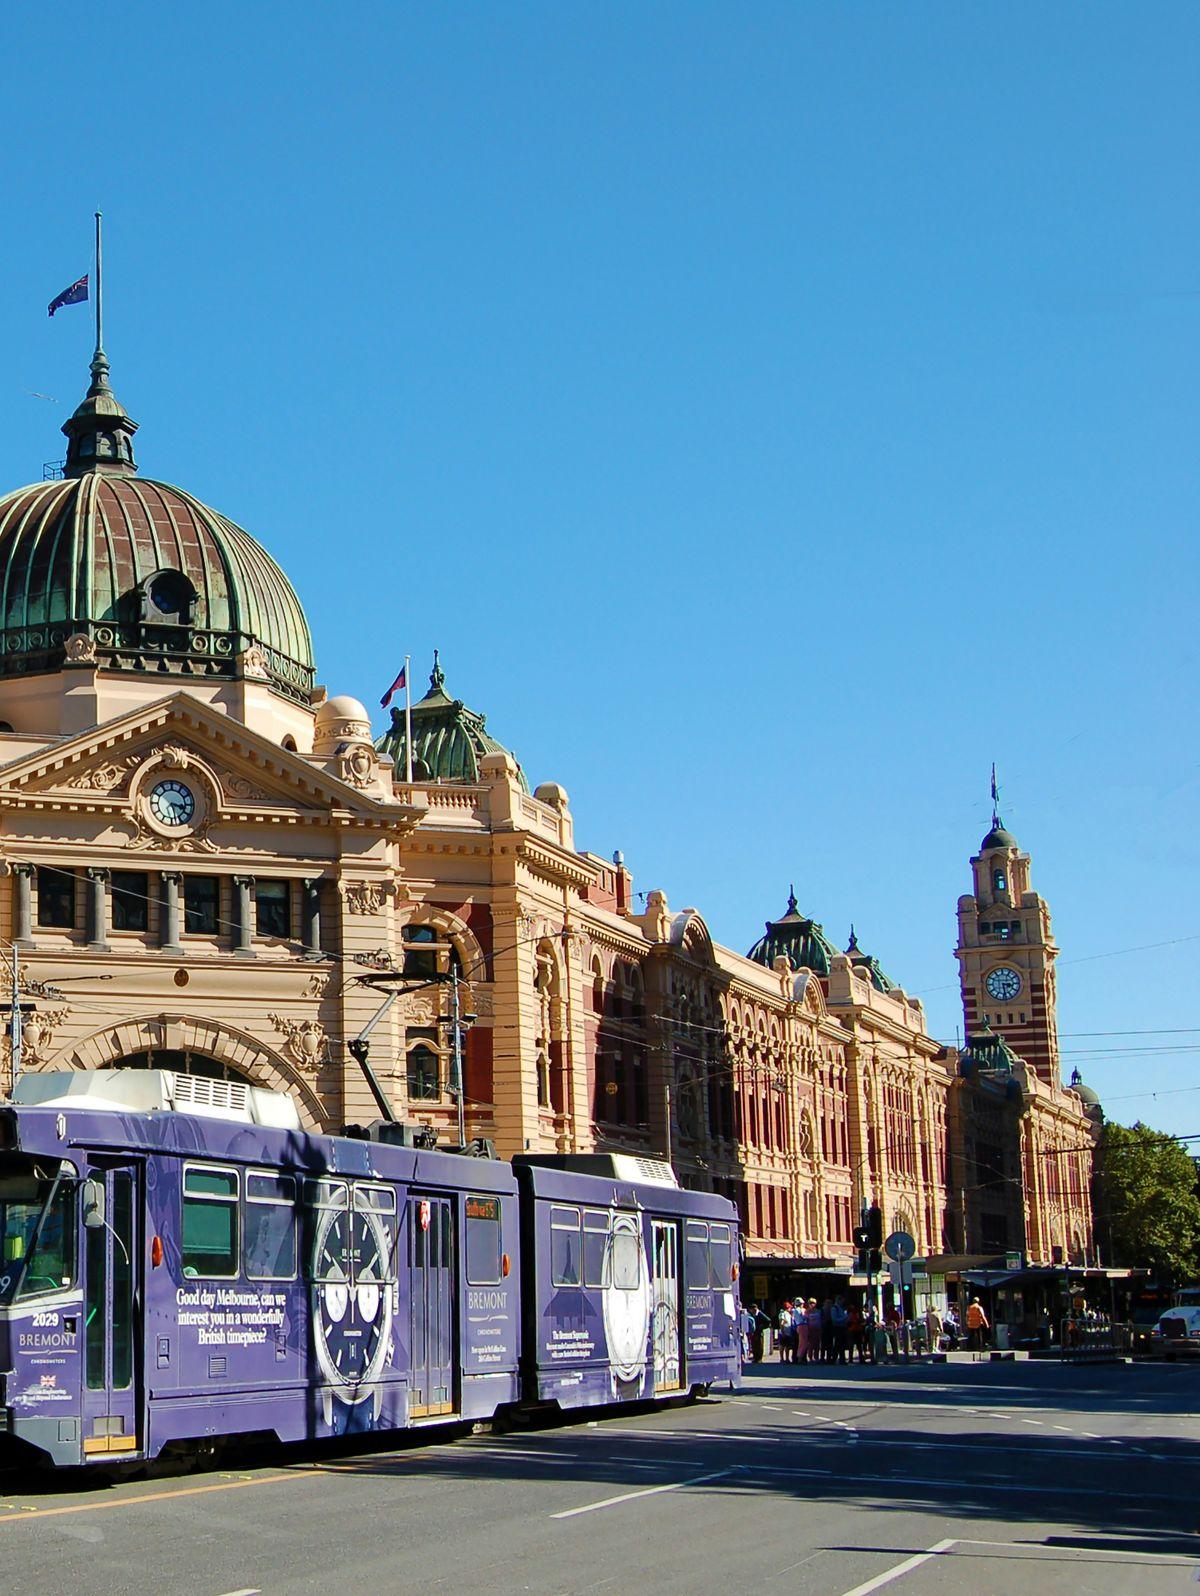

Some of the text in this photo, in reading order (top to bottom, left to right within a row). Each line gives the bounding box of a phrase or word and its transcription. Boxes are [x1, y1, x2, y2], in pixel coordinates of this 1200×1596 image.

[176, 1288, 286, 1309] Good day Melbourne, can we
[469, 1292, 507, 1309] BREMONT
[32, 1312, 59, 1327] 2029
[178, 1308, 284, 1328] interest you in a wonderfully
[19, 1333, 77, 1346] BREMONT
[198, 1327, 267, 1347] British timepiece?
